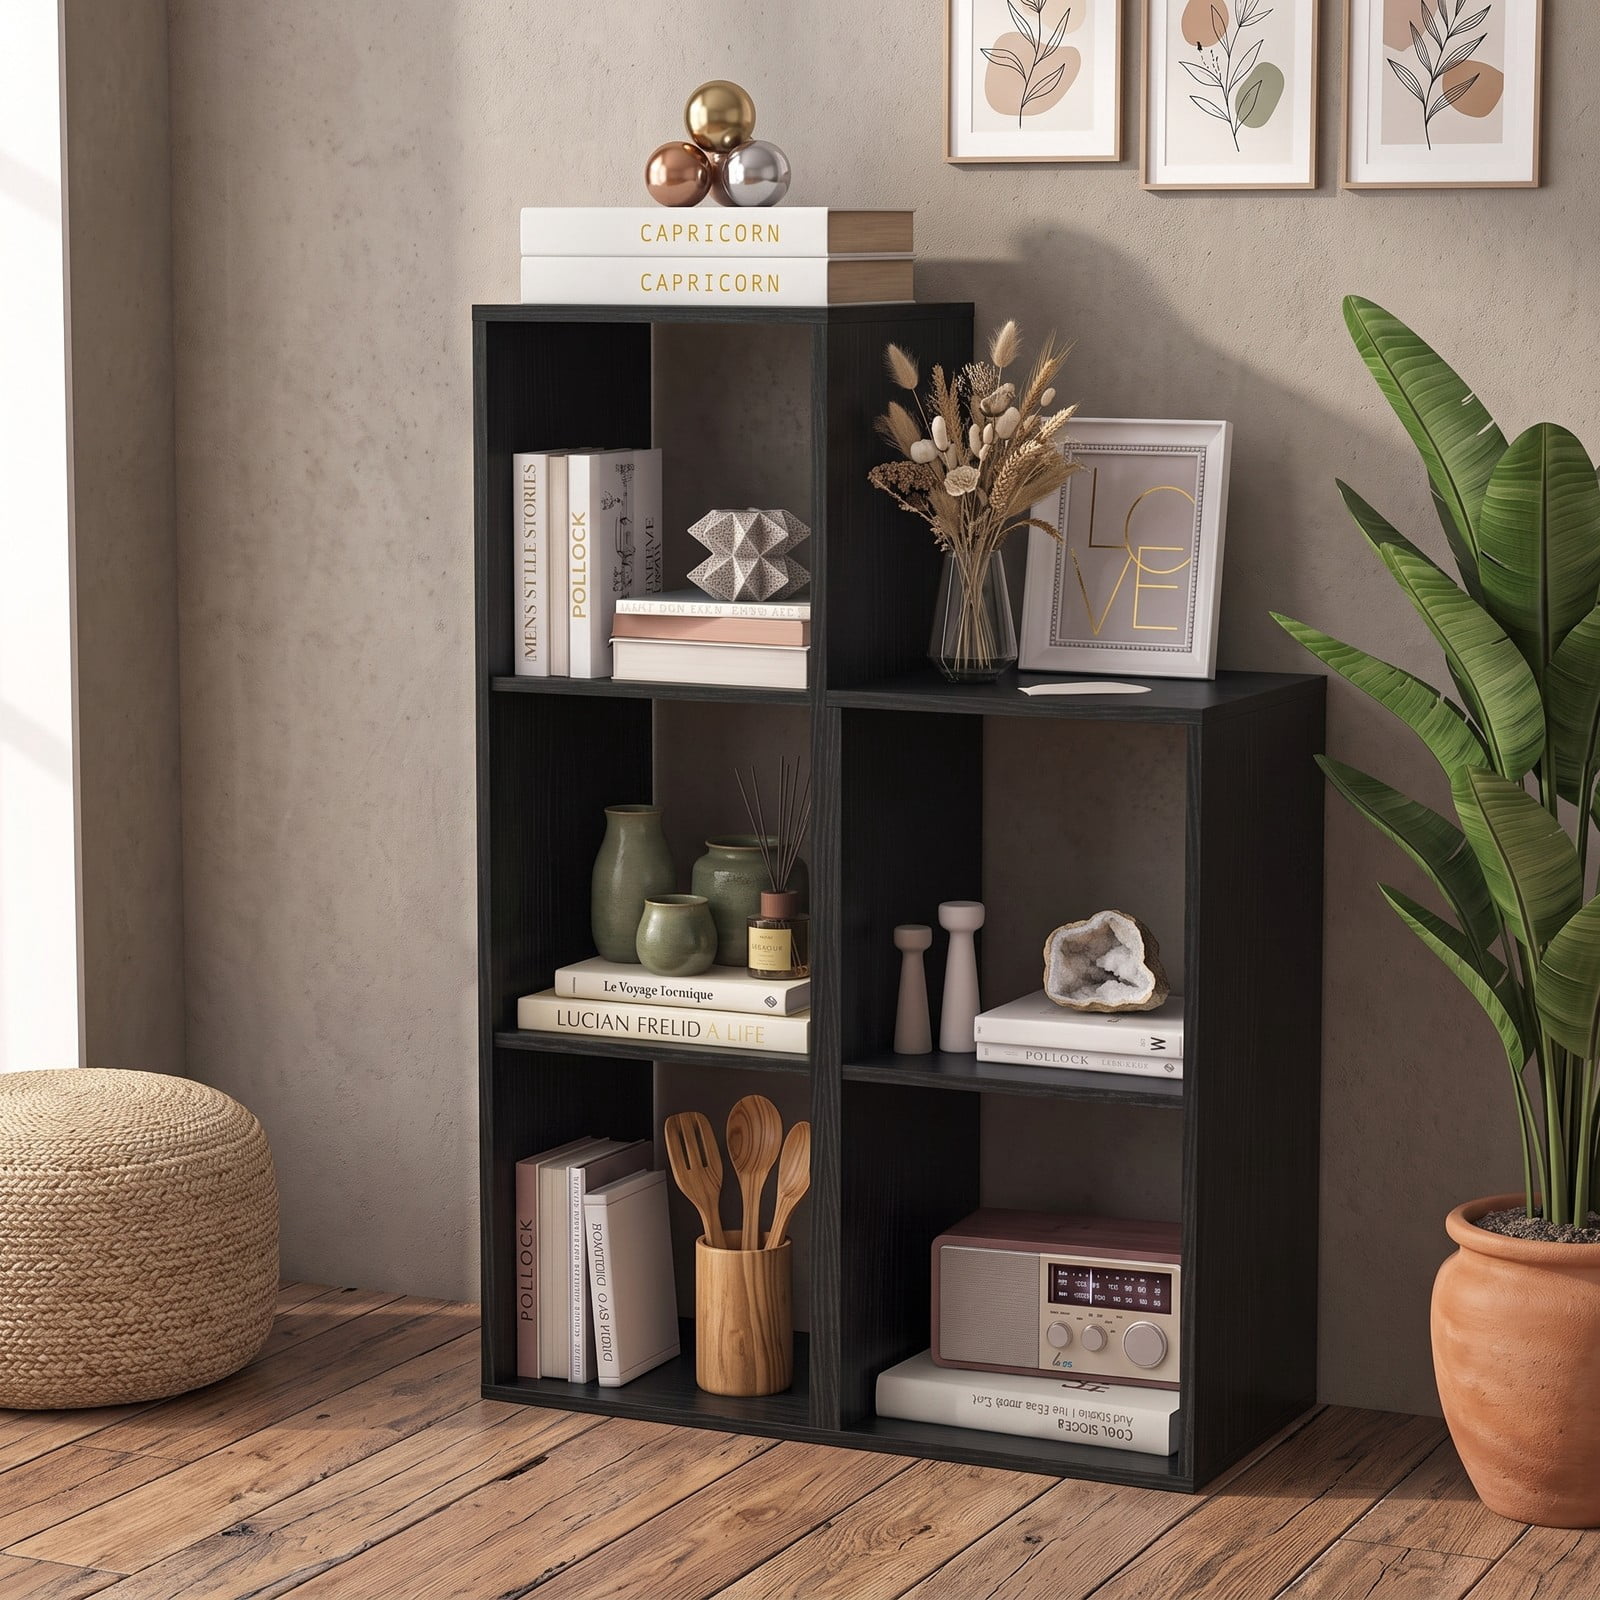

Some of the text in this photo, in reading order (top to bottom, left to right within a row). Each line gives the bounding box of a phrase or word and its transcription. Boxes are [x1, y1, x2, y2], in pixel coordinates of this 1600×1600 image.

[640, 223, 780, 243] CAPRICORN
[640, 273, 780, 293] CAPRICORN
[523, 463, 537, 539] STORIES
[572, 512, 586, 619] POLLOCK
[604, 980, 617, 992] Le
[619, 981, 658, 999] Voyage
[556, 1009, 630, 1032] LUCIAN
[705, 1022, 720, 1040] A
[727, 1023, 765, 1044] LIFE
[1025, 1050, 1089, 1065] POLLOCK
[520, 1218, 533, 1321] POLLOCK
